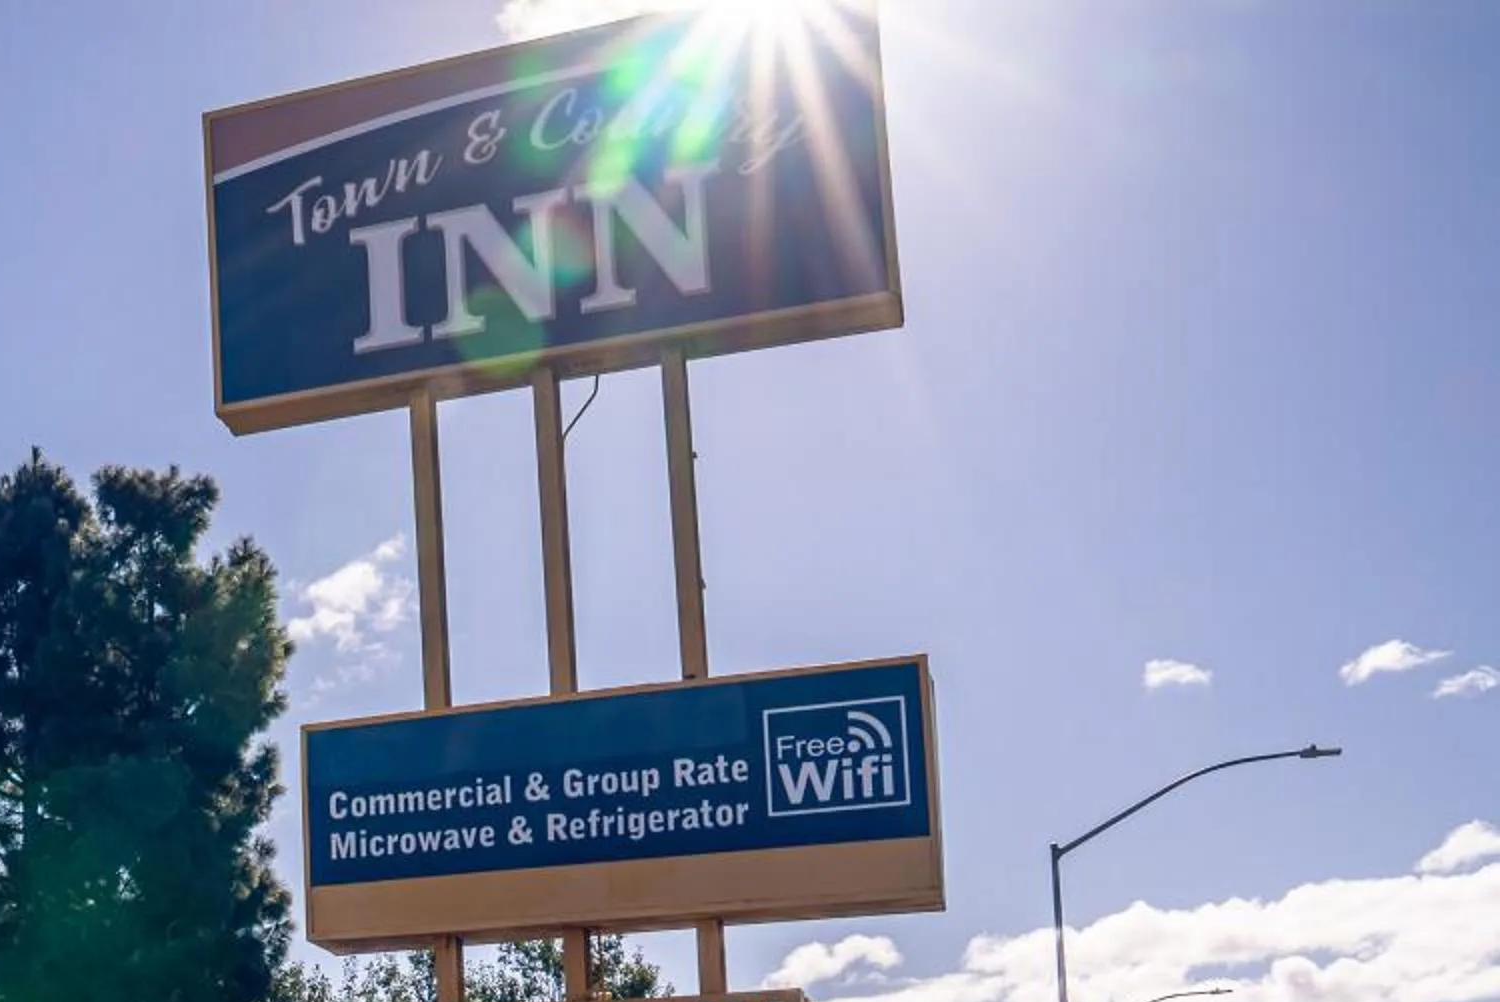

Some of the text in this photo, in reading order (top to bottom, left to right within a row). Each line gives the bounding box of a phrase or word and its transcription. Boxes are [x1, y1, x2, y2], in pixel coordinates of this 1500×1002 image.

[266, 88, 806, 245] Town & Cory
[350, 158, 722, 355] INN
[776, 735, 845, 760] Free
[329, 754, 749, 819] Commercial & Group Rate
[778, 753, 895, 805] Wifi
[330, 800, 749, 860] Microwave & Refrigerator
